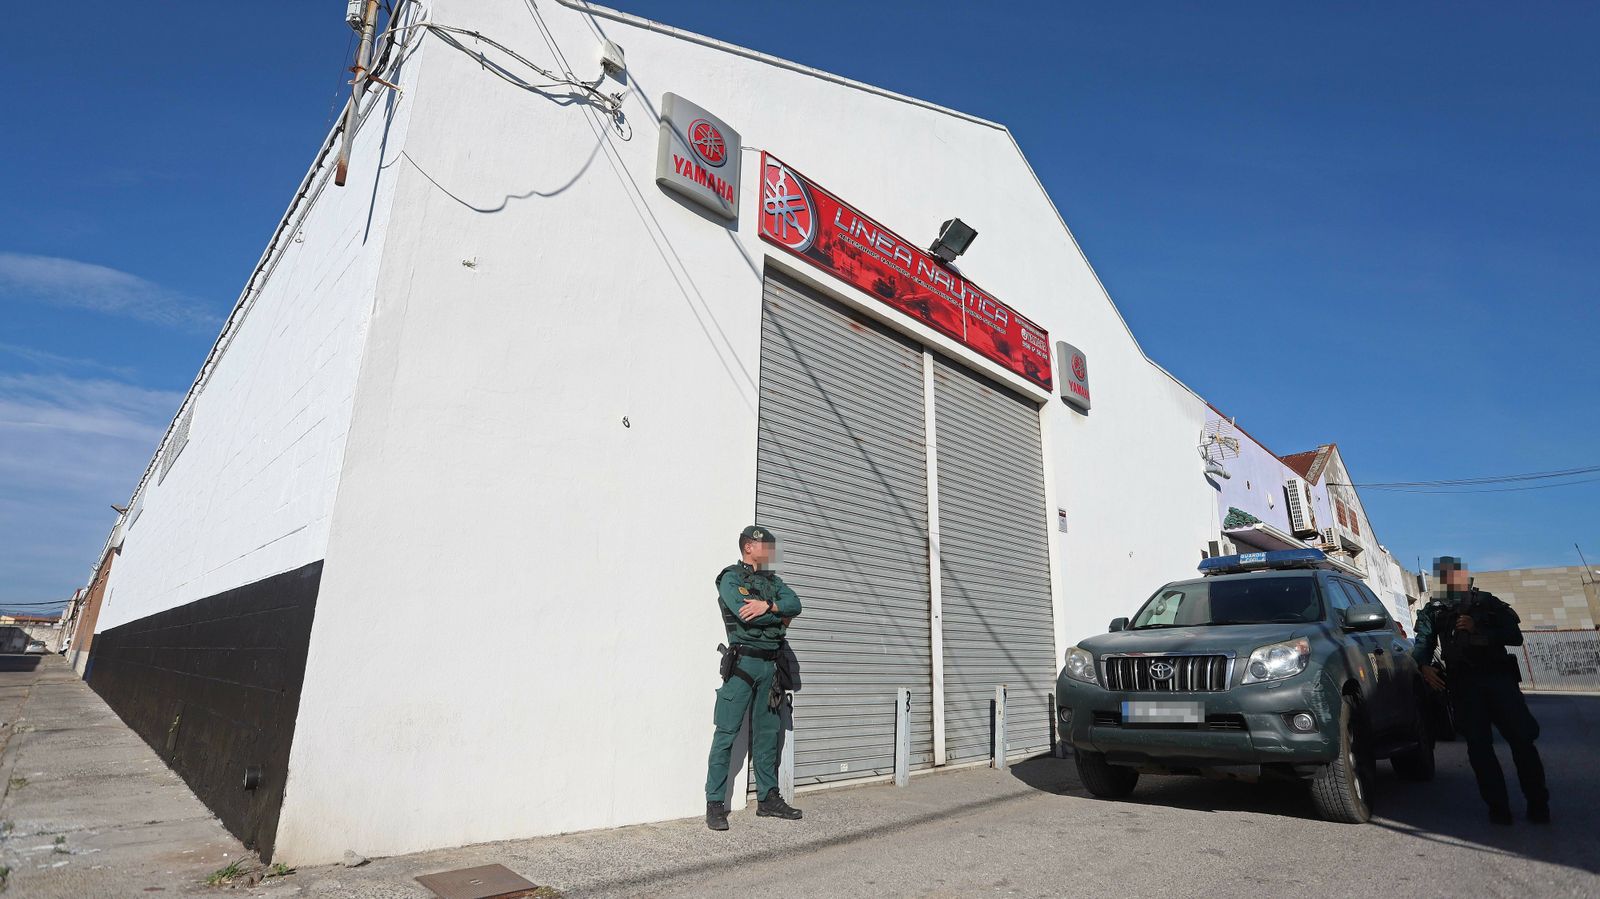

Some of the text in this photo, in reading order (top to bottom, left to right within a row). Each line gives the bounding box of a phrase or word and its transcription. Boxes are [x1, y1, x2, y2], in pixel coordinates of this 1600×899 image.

[673, 154, 734, 205] YAMAHA
[834, 207, 912, 269] LINEA
[917, 258, 1008, 327] NAUTICA
[1068, 379, 1090, 399] YAMAHA
